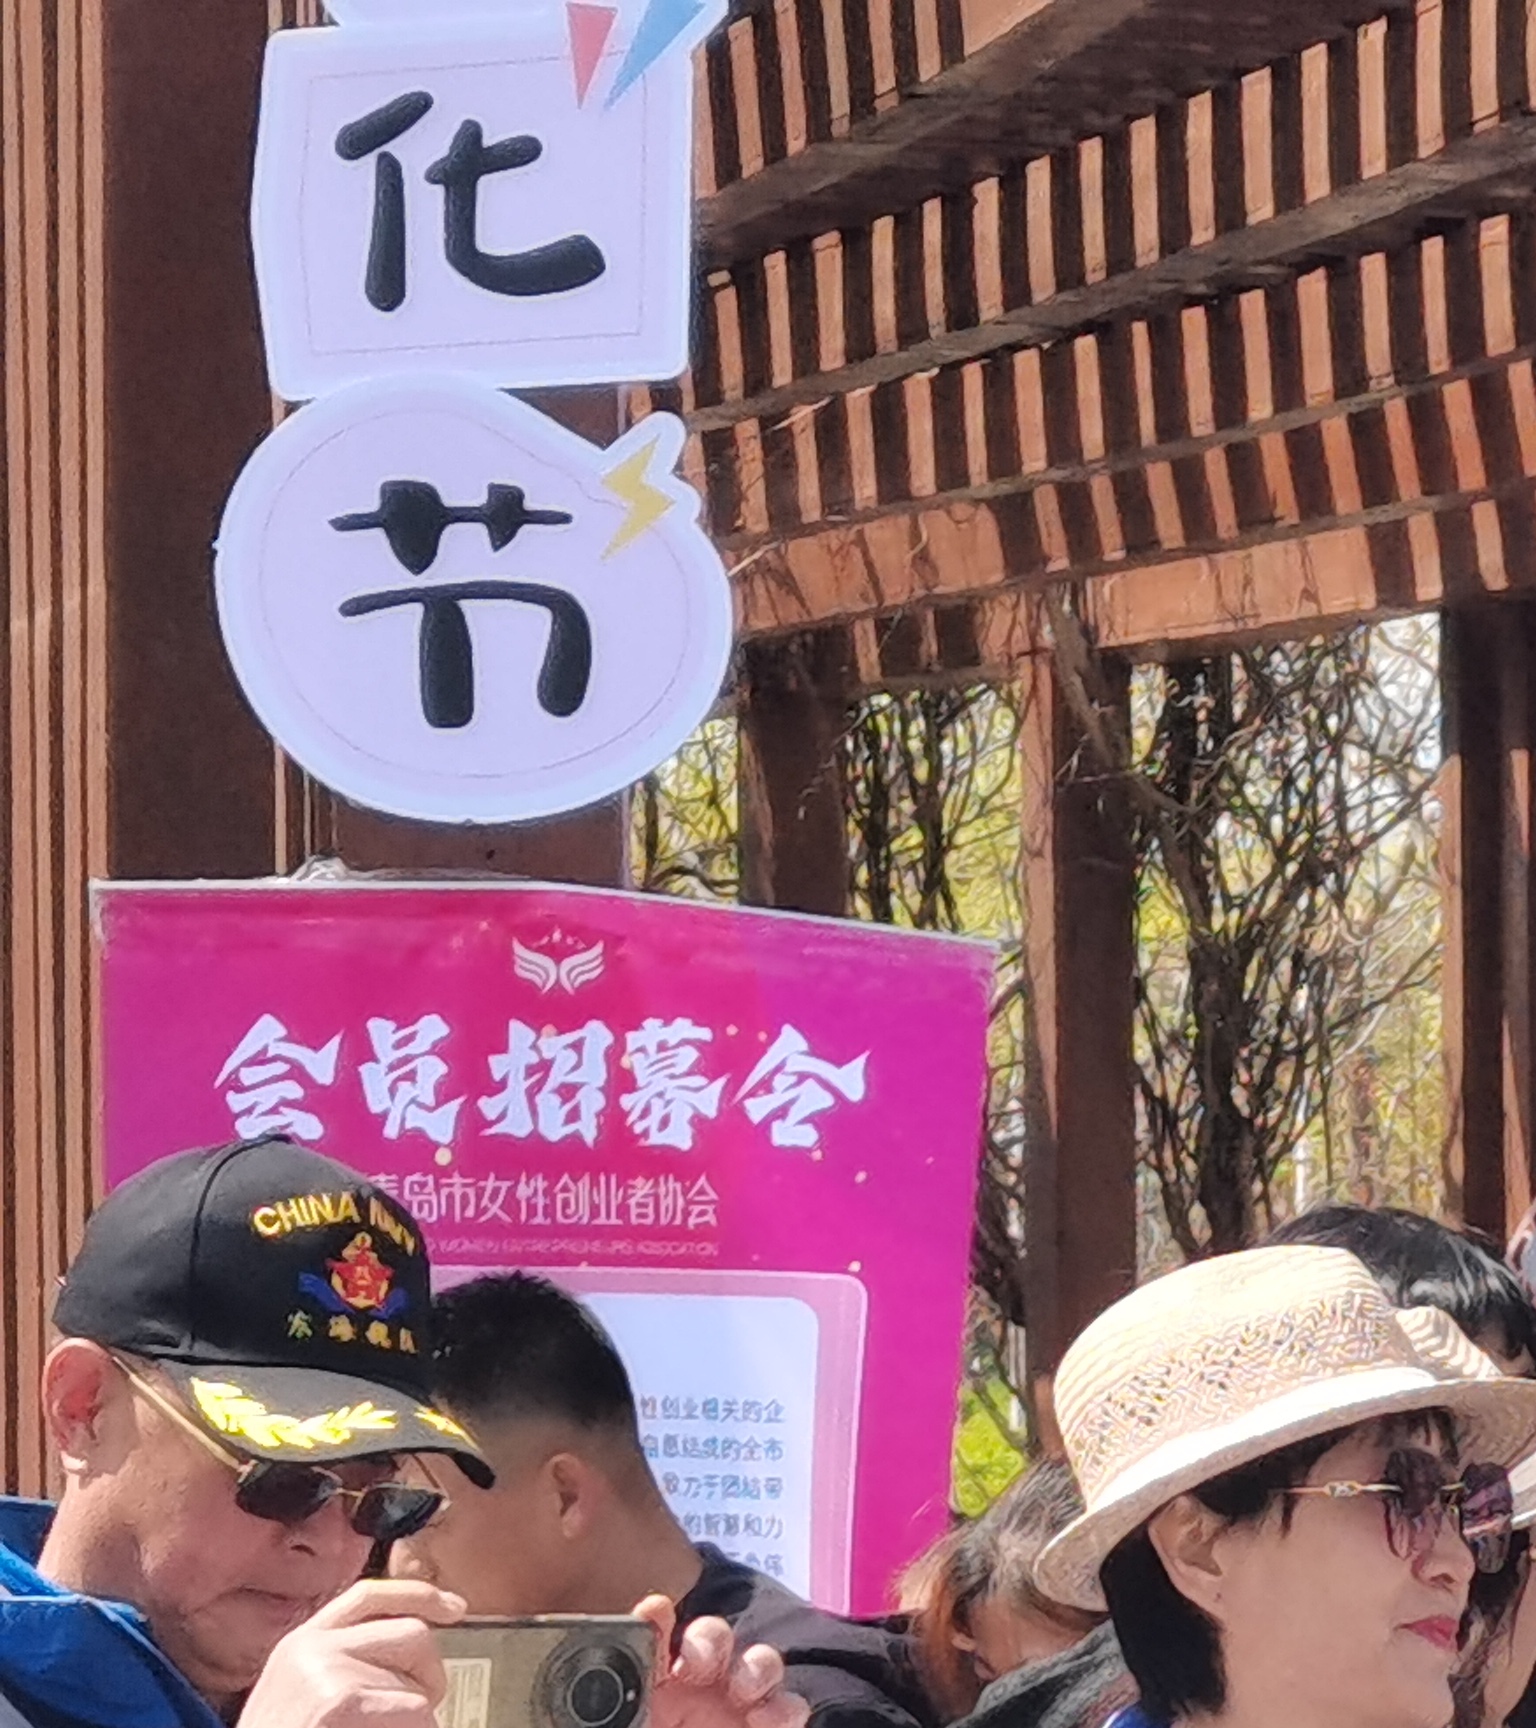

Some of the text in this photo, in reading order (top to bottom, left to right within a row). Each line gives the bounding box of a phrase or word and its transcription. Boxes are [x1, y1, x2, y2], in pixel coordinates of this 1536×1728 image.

[213, 1013, 871, 1152] 会员招募令
[252, 1190, 361, 1237] CHINA
